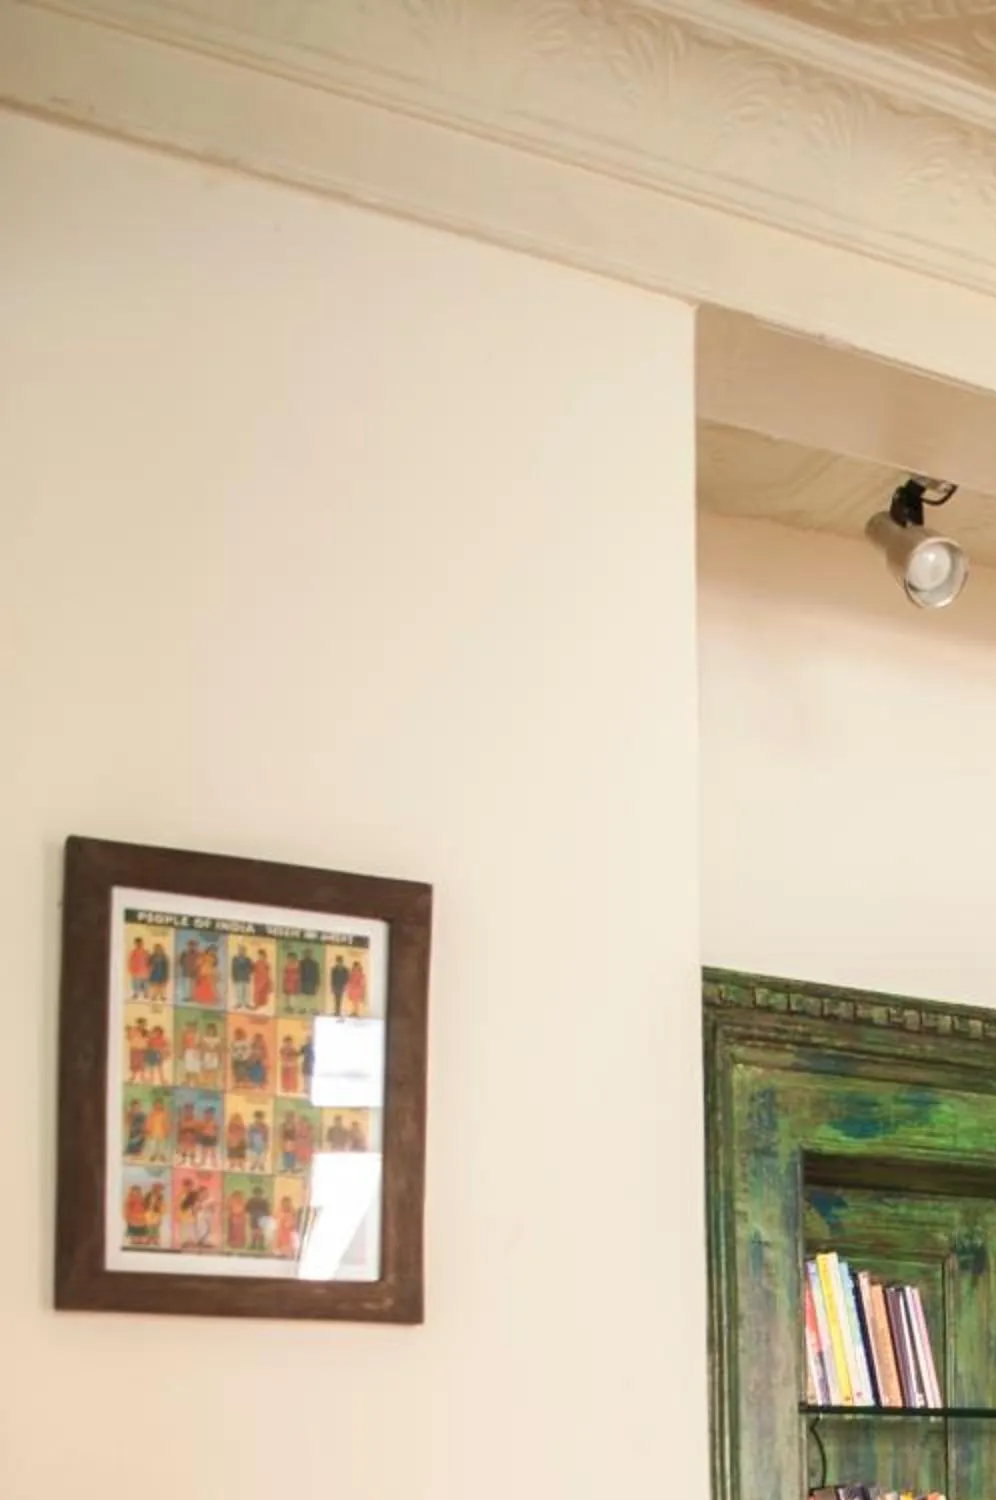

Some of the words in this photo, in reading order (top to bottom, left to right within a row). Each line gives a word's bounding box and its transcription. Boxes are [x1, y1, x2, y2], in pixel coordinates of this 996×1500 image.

[137, 911, 189, 926] PEOPLE
[193, 917, 212, 929] OF
[215, 919, 256, 934] INDIA
